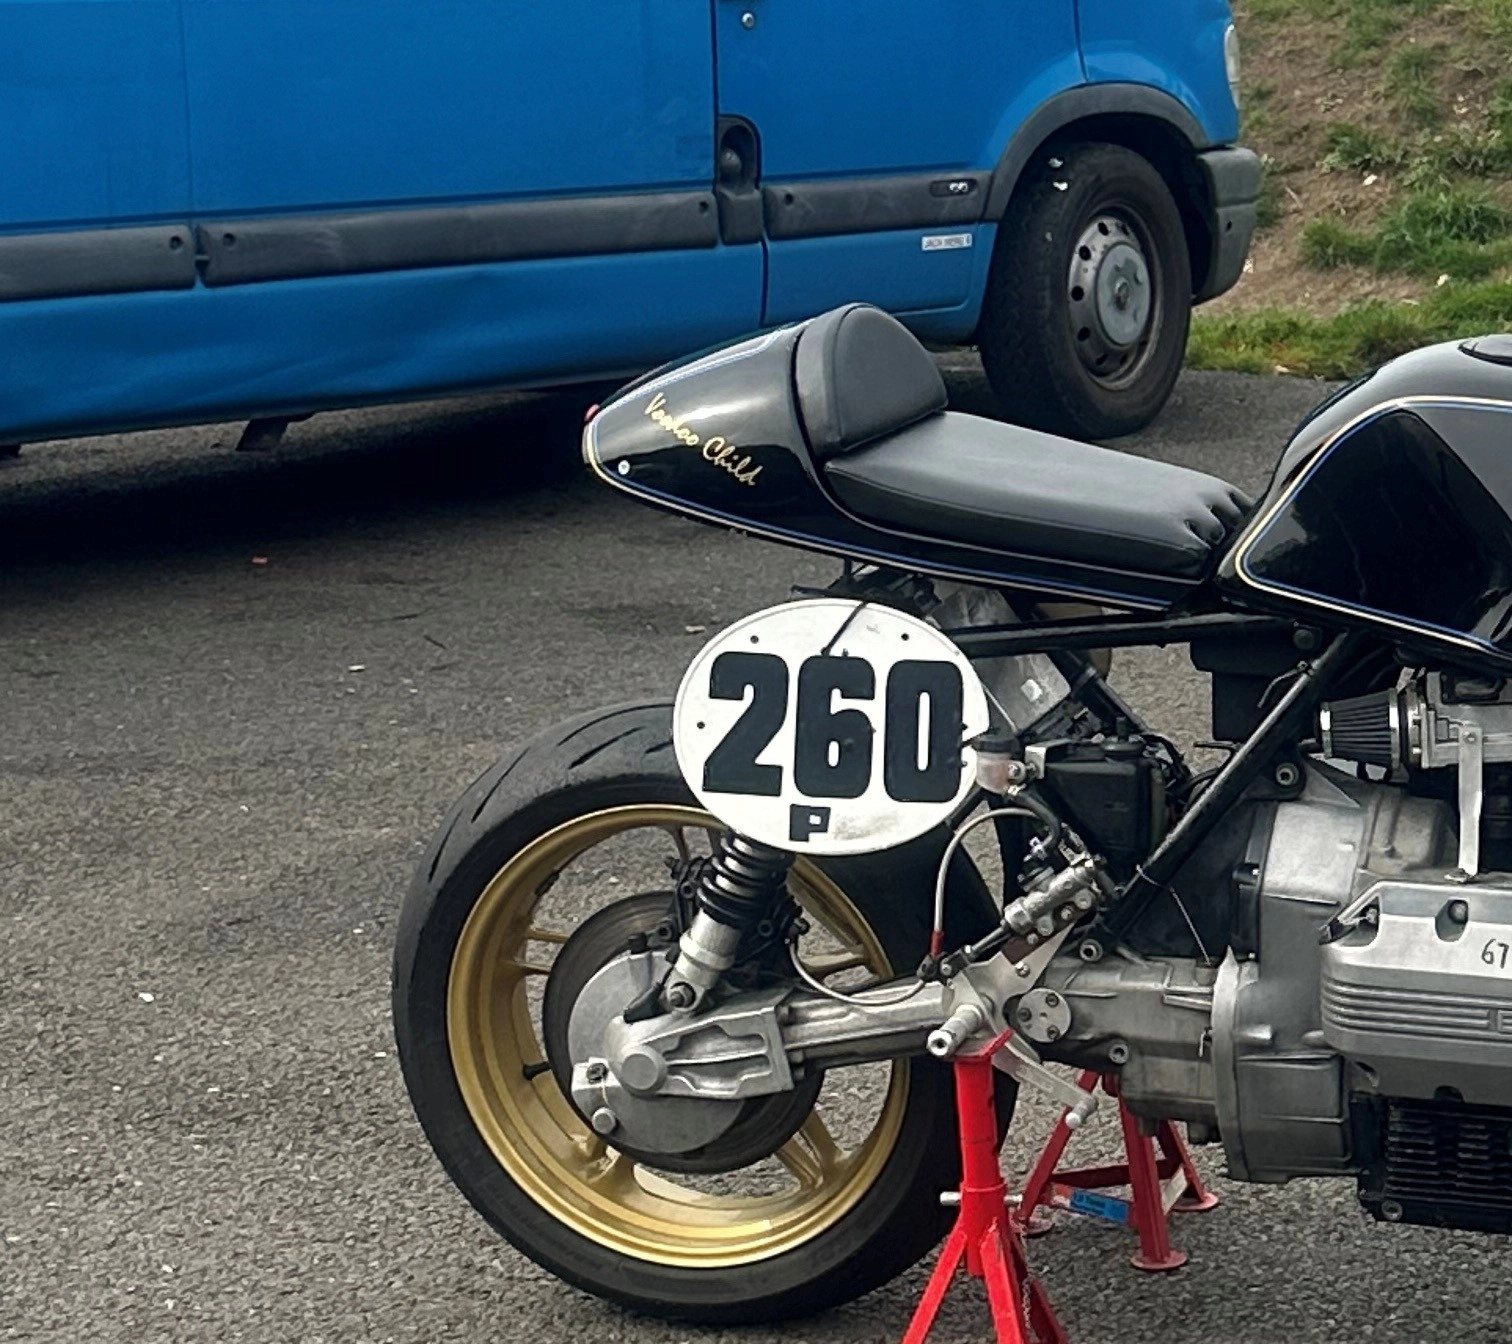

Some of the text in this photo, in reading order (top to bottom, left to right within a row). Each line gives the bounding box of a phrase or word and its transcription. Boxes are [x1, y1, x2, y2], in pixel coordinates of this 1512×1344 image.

[702, 436, 763, 486] Child
[702, 651, 964, 803] 260
[789, 803, 831, 843] P
